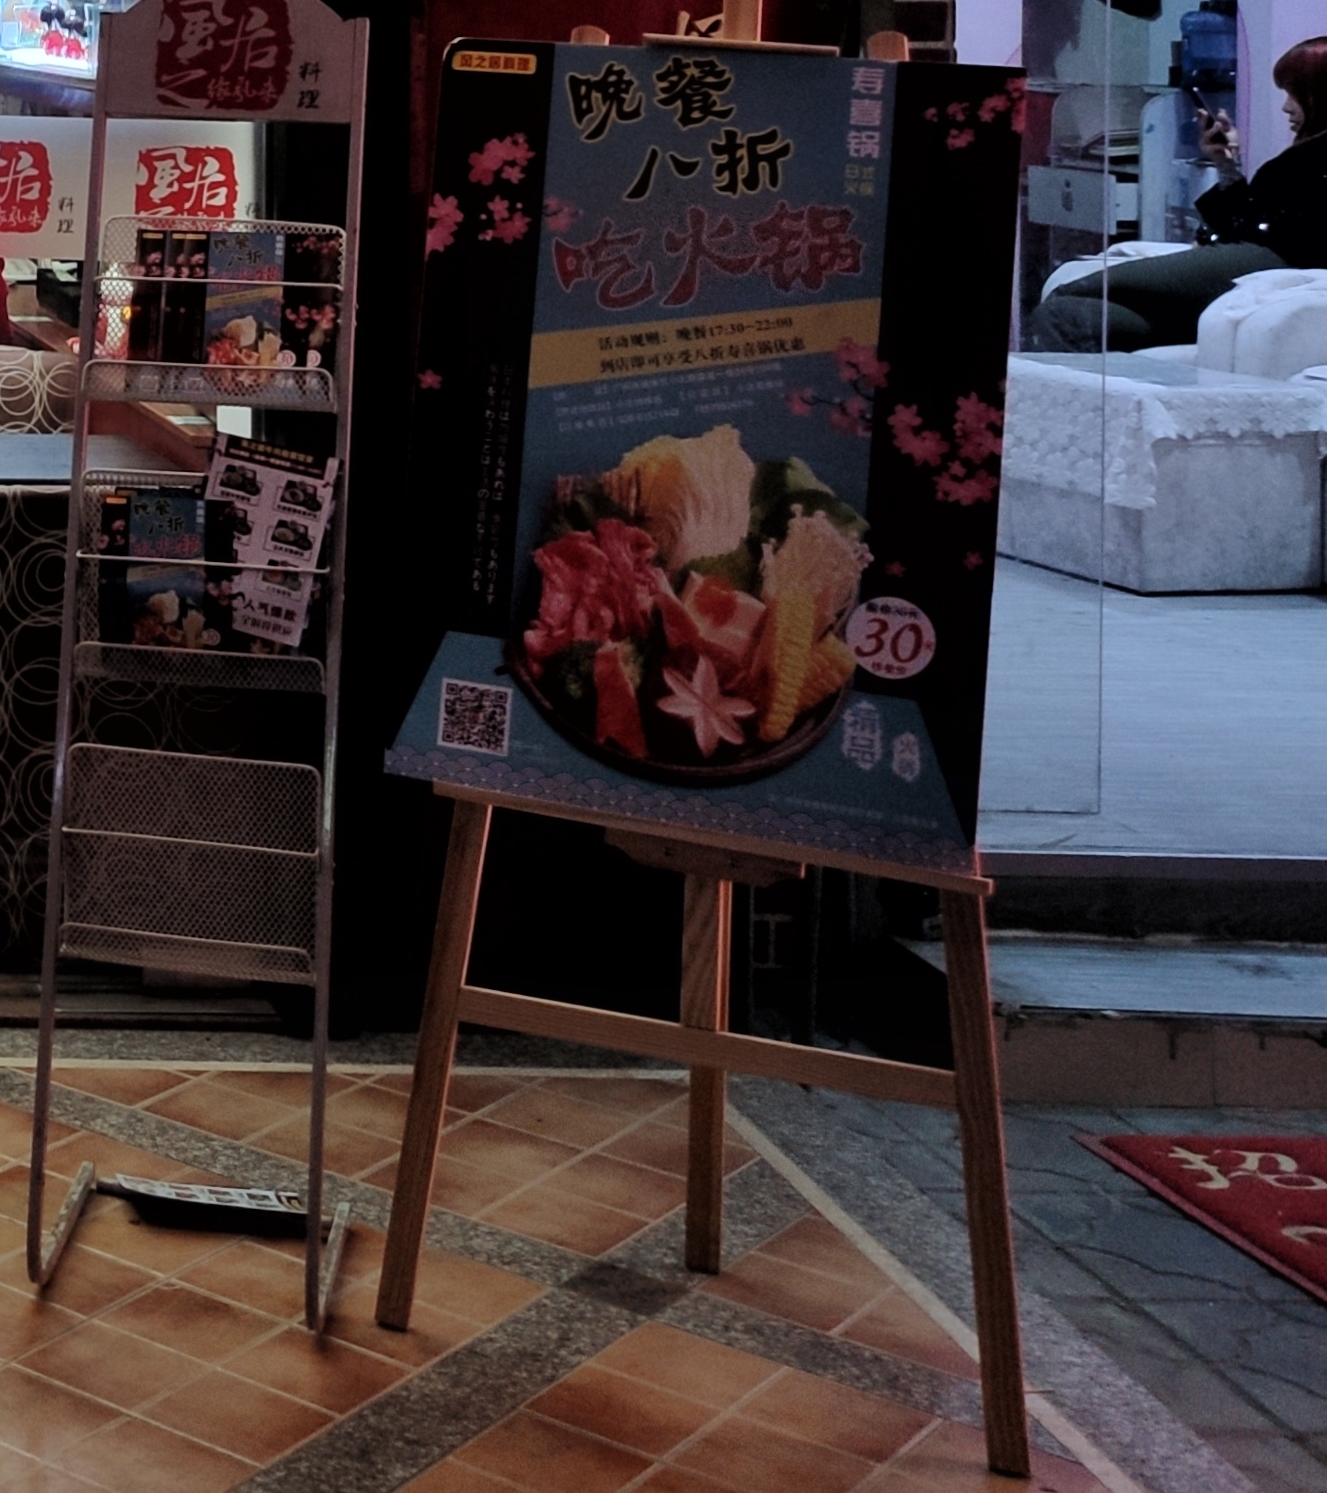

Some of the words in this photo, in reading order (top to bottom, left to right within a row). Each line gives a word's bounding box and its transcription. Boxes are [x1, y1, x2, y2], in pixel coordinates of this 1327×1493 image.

[566, 54, 736, 142] 晚餐
[846, 66, 886, 159] 寿喜锅
[622, 127, 794, 201] 八折
[552, 200, 868, 310] 吃火锅
[853, 617, 924, 664] 30
